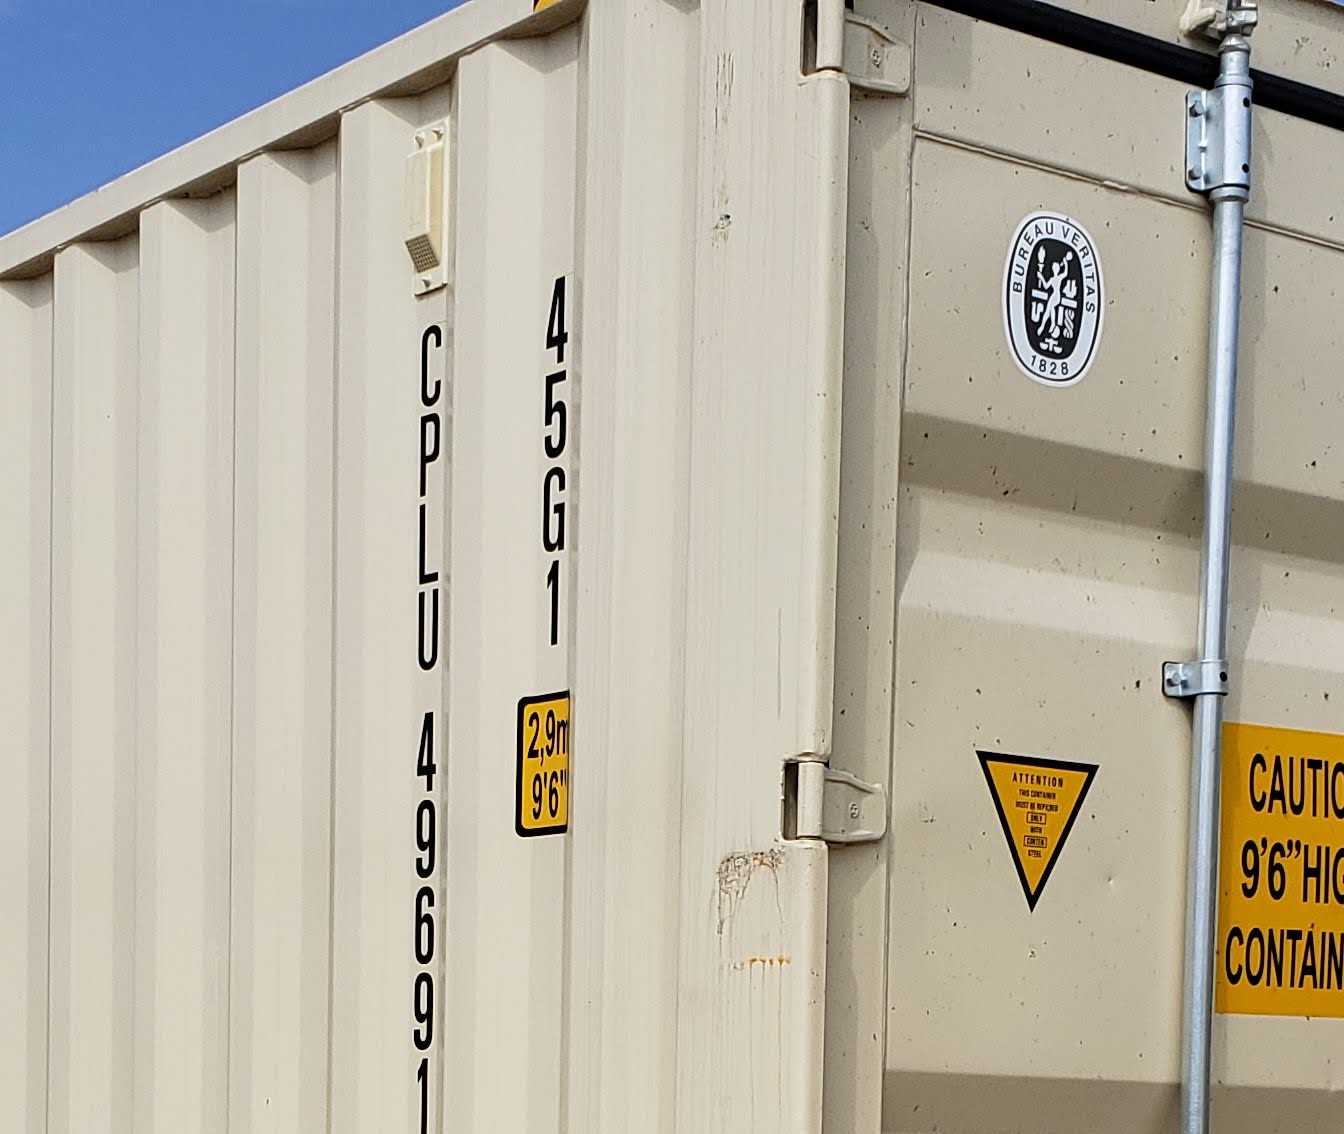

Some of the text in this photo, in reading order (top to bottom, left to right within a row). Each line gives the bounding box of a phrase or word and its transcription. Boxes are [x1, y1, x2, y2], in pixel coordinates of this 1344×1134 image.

[1013, 222, 1096, 314] BUREAU VERITAS
[1030, 355, 1069, 376] 1828
[416, 324, 443, 671] CPLU
[543, 275, 568, 646] 45G1
[1012, 772, 1064, 788] ATTENTION
